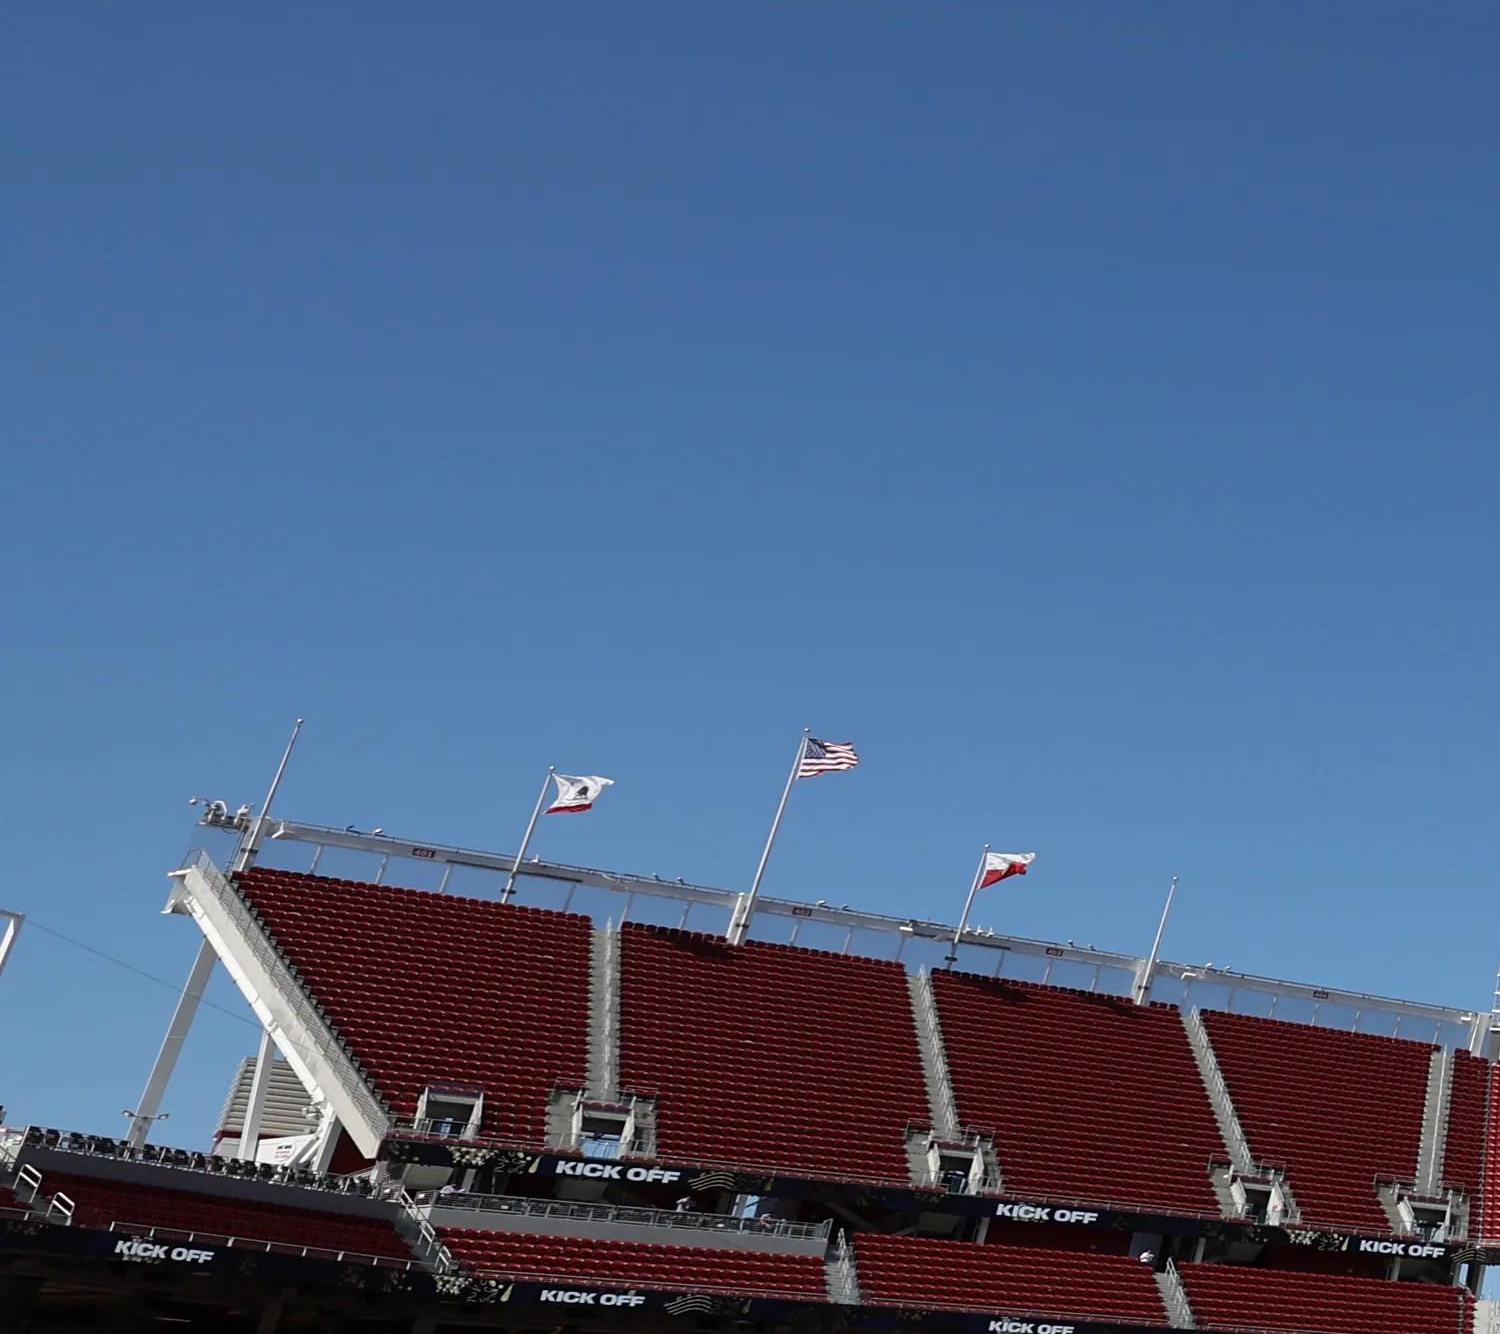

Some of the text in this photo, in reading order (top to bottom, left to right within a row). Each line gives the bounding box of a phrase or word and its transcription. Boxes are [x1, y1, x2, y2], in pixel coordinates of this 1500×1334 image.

[556, 1161, 680, 1183] KICK OFF
[996, 1204, 1098, 1223] KICK OFF
[115, 1239, 214, 1263] KICK OFF
[1360, 1240, 1446, 1259] KICK OFF
[540, 1290, 645, 1306] KICK OFF
[989, 1319, 1034, 1334] KICK
